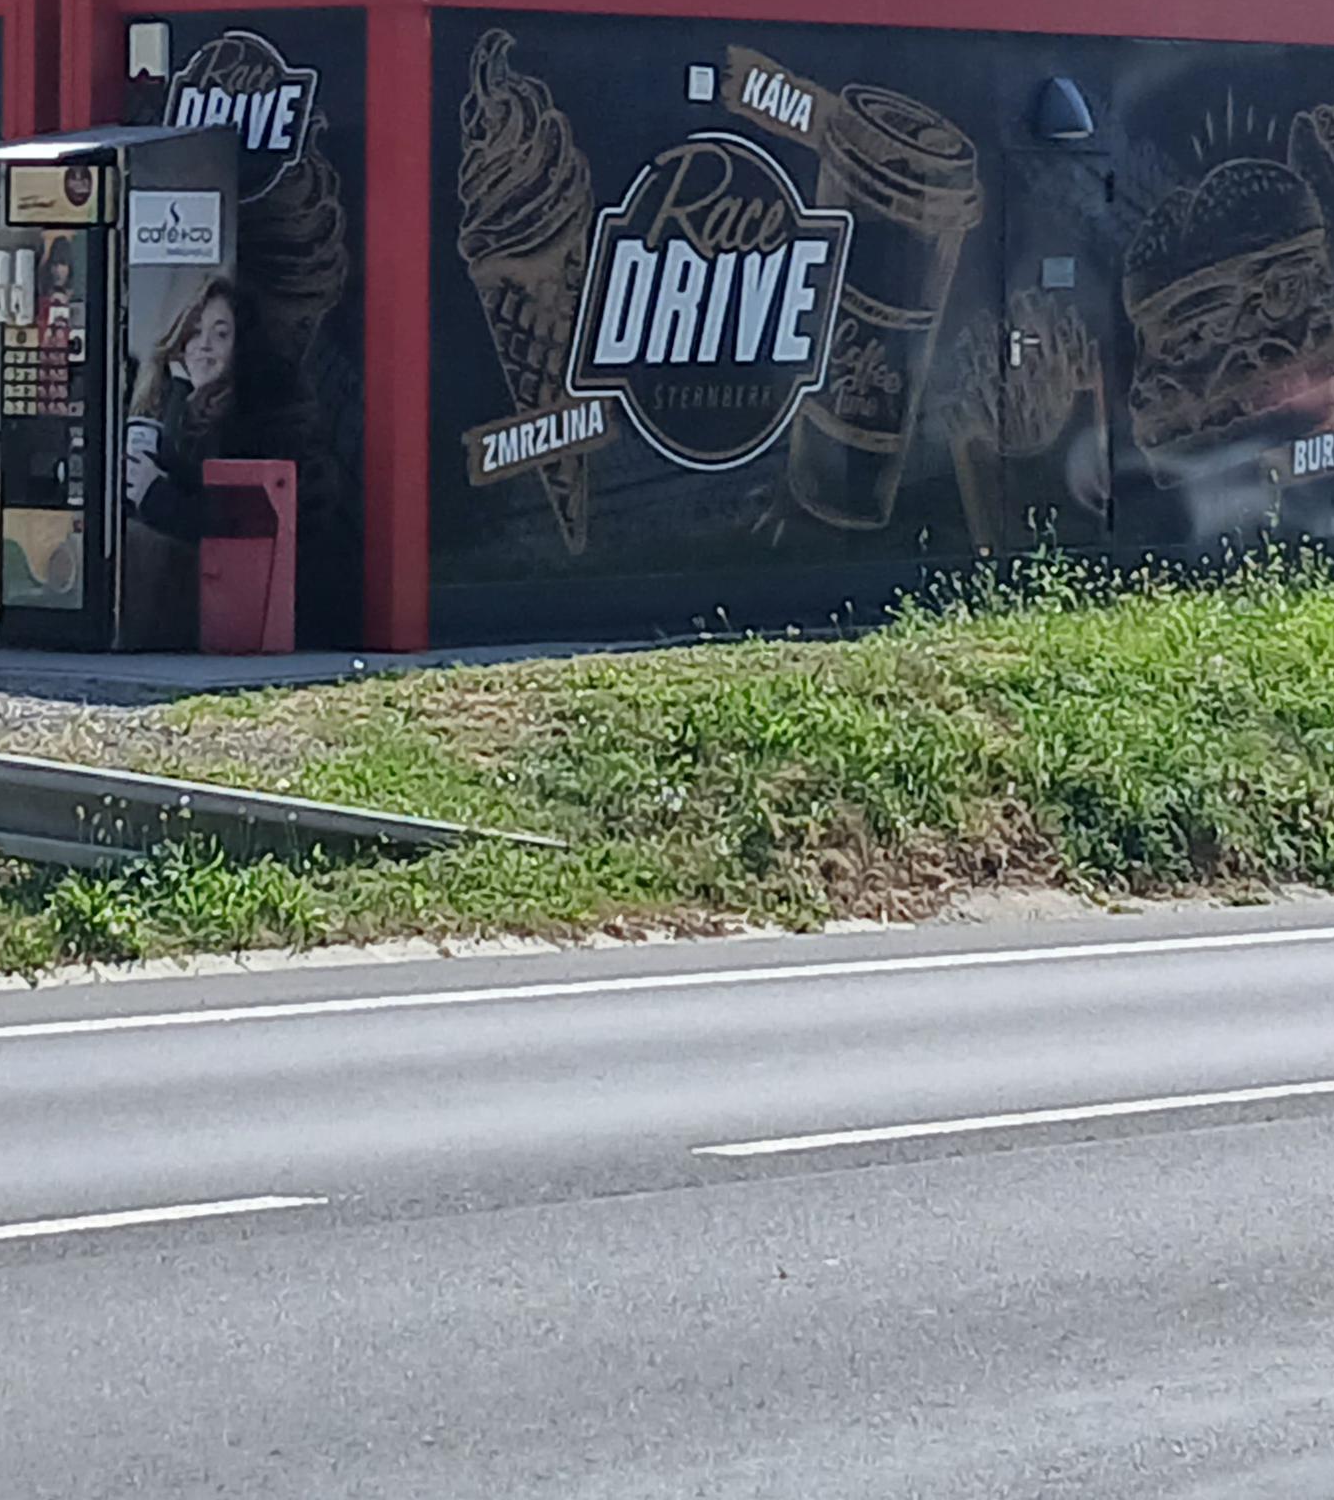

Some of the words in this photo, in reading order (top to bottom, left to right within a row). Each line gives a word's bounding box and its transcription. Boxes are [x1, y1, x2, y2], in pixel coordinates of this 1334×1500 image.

[175, 85, 302, 149] DRIVE
[742, 67, 813, 133] KÁVA
[653, 142, 787, 258] Race
[593, 239, 829, 364] DRIVE
[482, 400, 604, 472] ZMRZLINA
